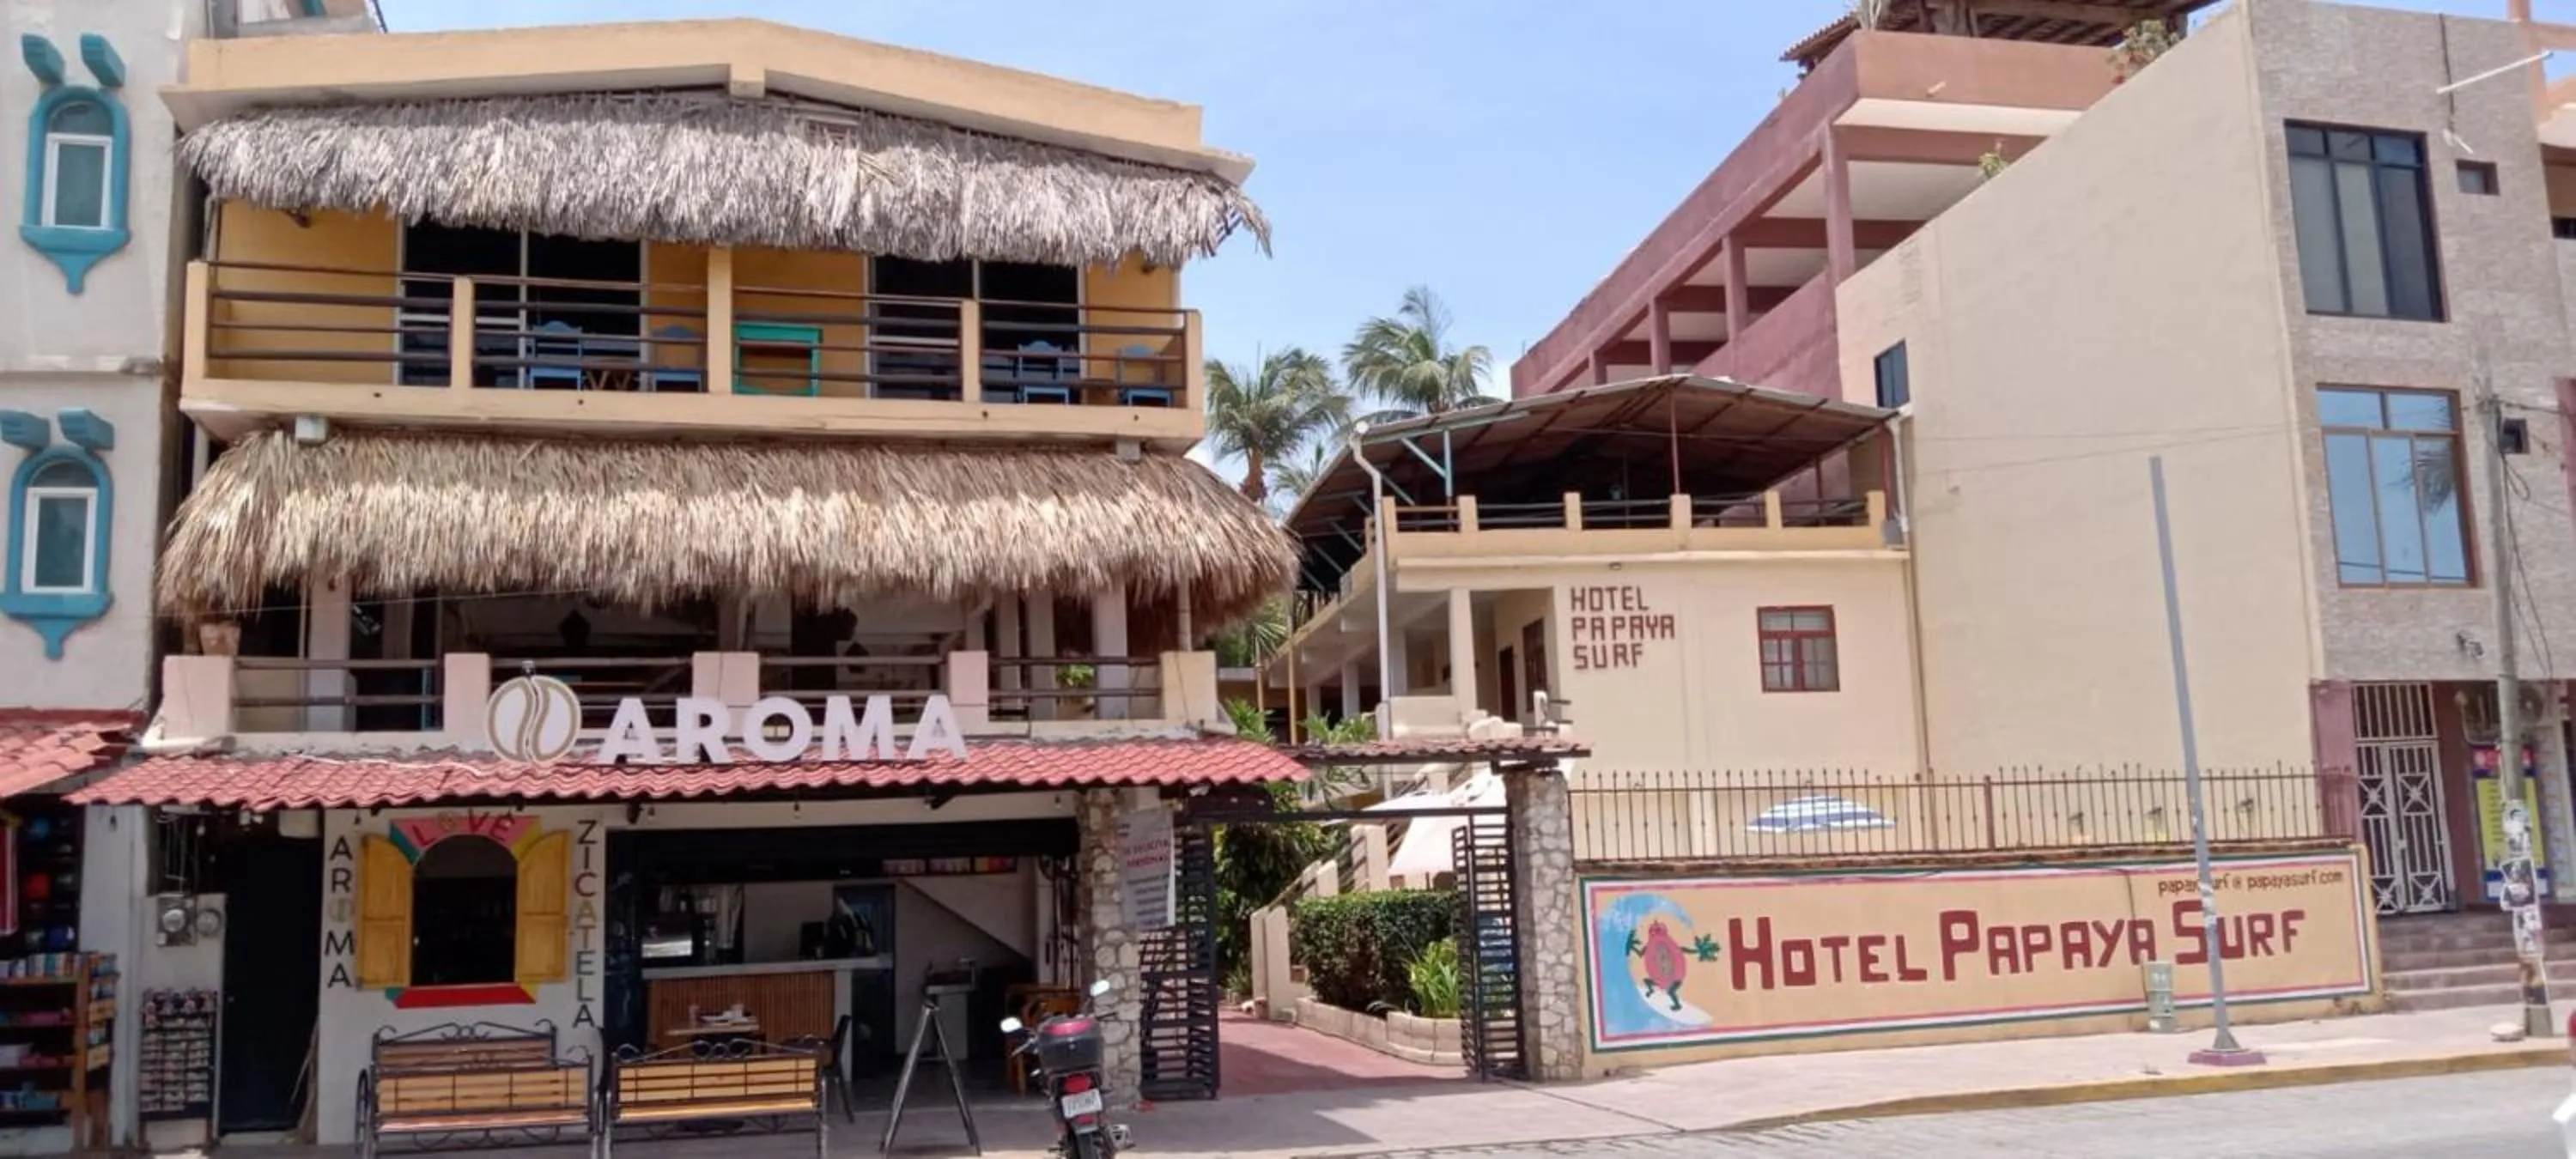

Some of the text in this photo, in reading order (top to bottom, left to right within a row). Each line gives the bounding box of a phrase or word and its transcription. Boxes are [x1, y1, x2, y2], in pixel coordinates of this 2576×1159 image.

[1571, 586, 1649, 612] HOTEL
[1572, 614, 1675, 640] PAPAYA
[1573, 643, 1644, 670] SURF
[600, 694, 970, 765] AROMA
[412, 809, 517, 846] LOVE
[324, 834, 355, 989] AROMA
[573, 819, 598, 1029] ZICATELA
[1728, 900, 2306, 992] HOTEL PAPAYA SURF
